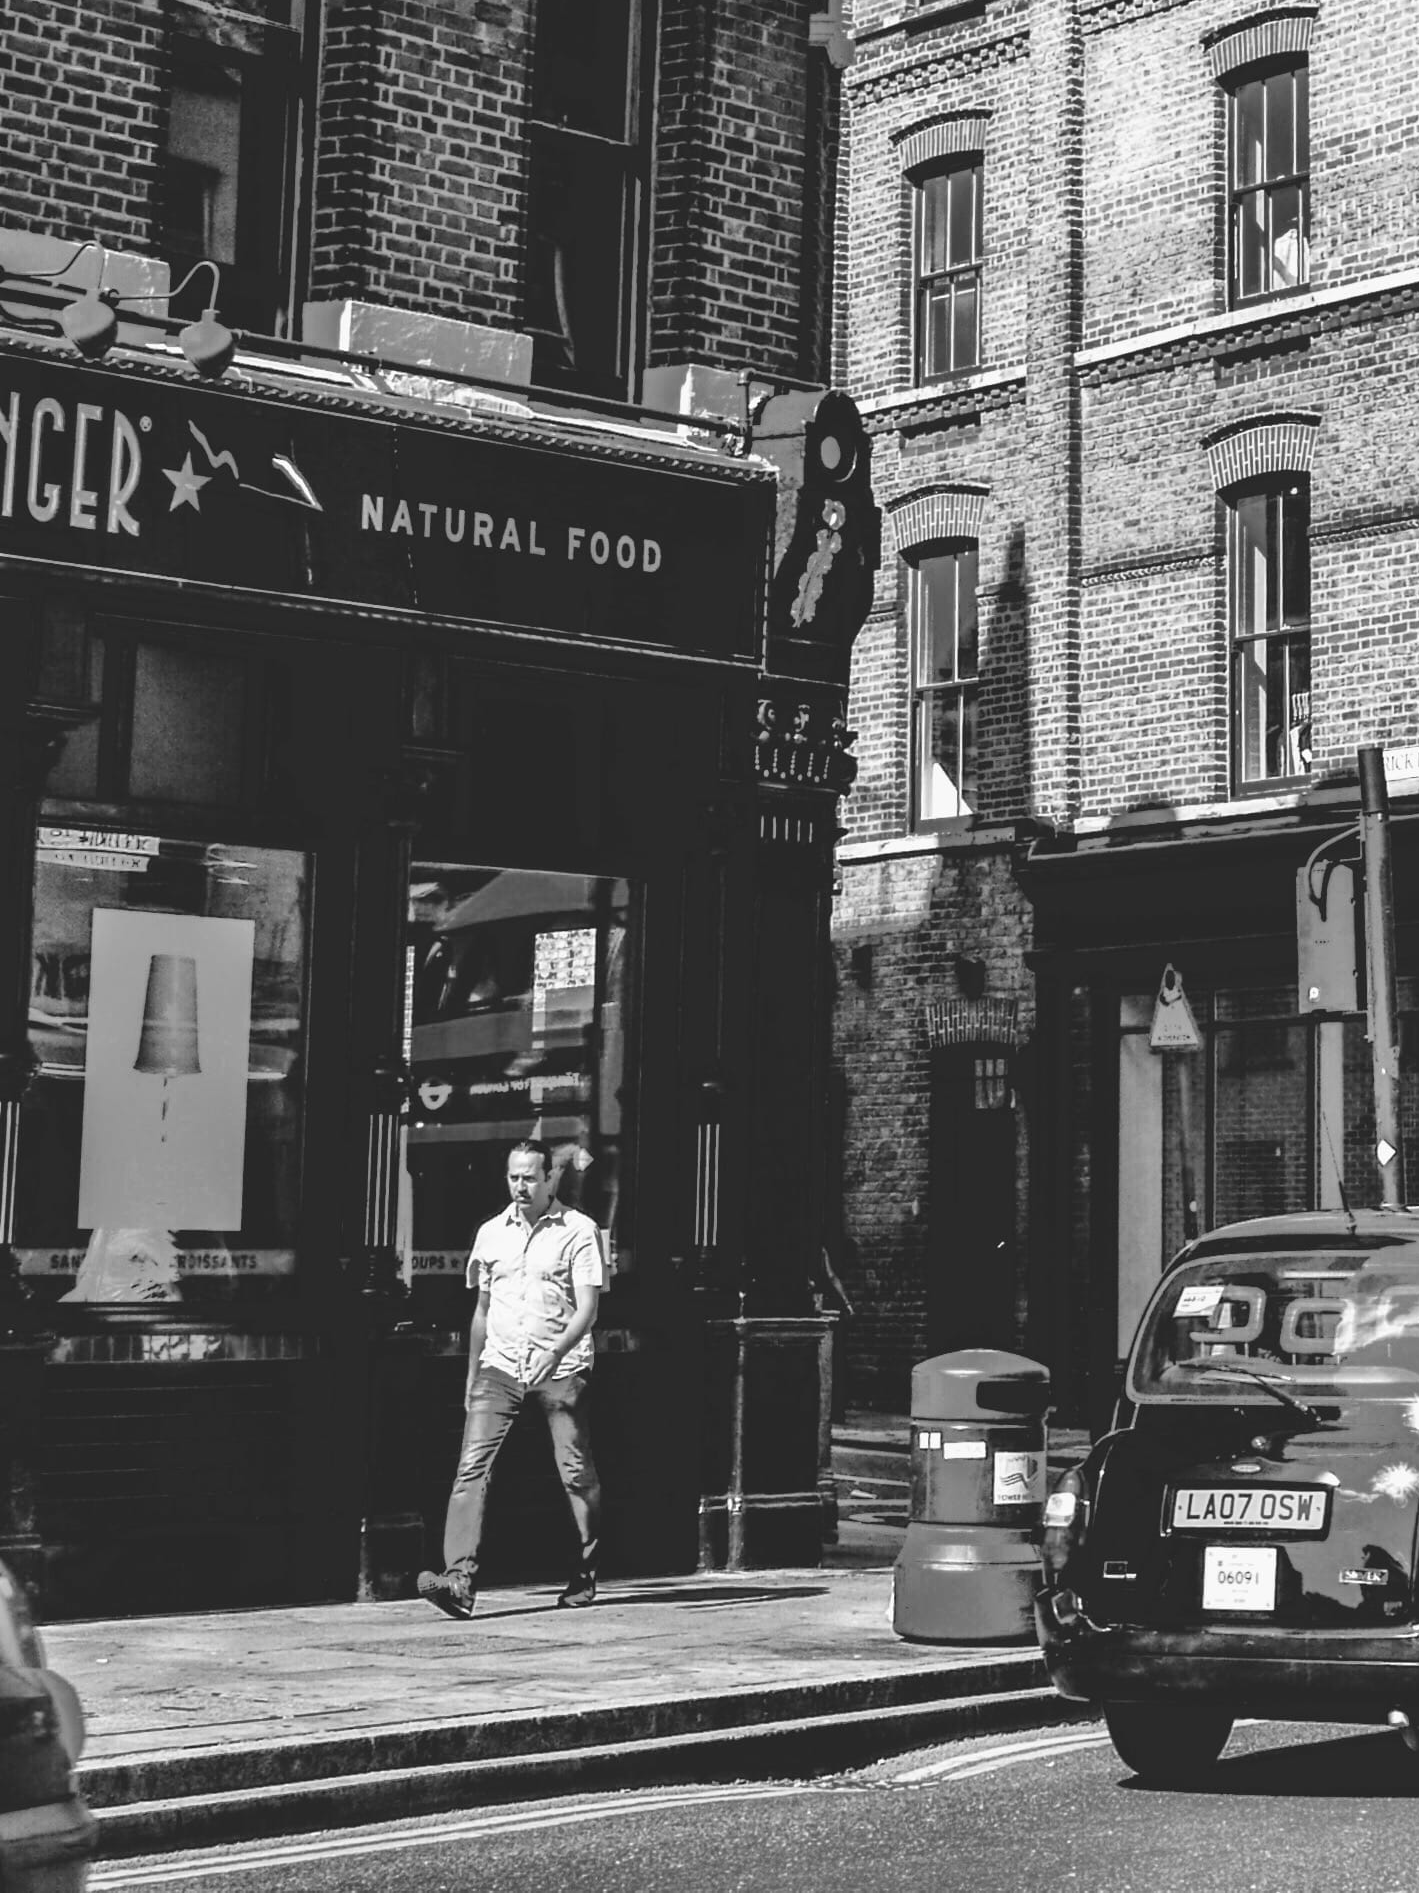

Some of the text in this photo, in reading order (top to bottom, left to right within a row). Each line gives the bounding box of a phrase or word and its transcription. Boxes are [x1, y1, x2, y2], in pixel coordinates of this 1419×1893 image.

[361, 493, 662, 573] NATURAL FOOD
[1260, 1494, 1313, 1521] OSW
[1218, 1571, 1260, 1585] 06091
